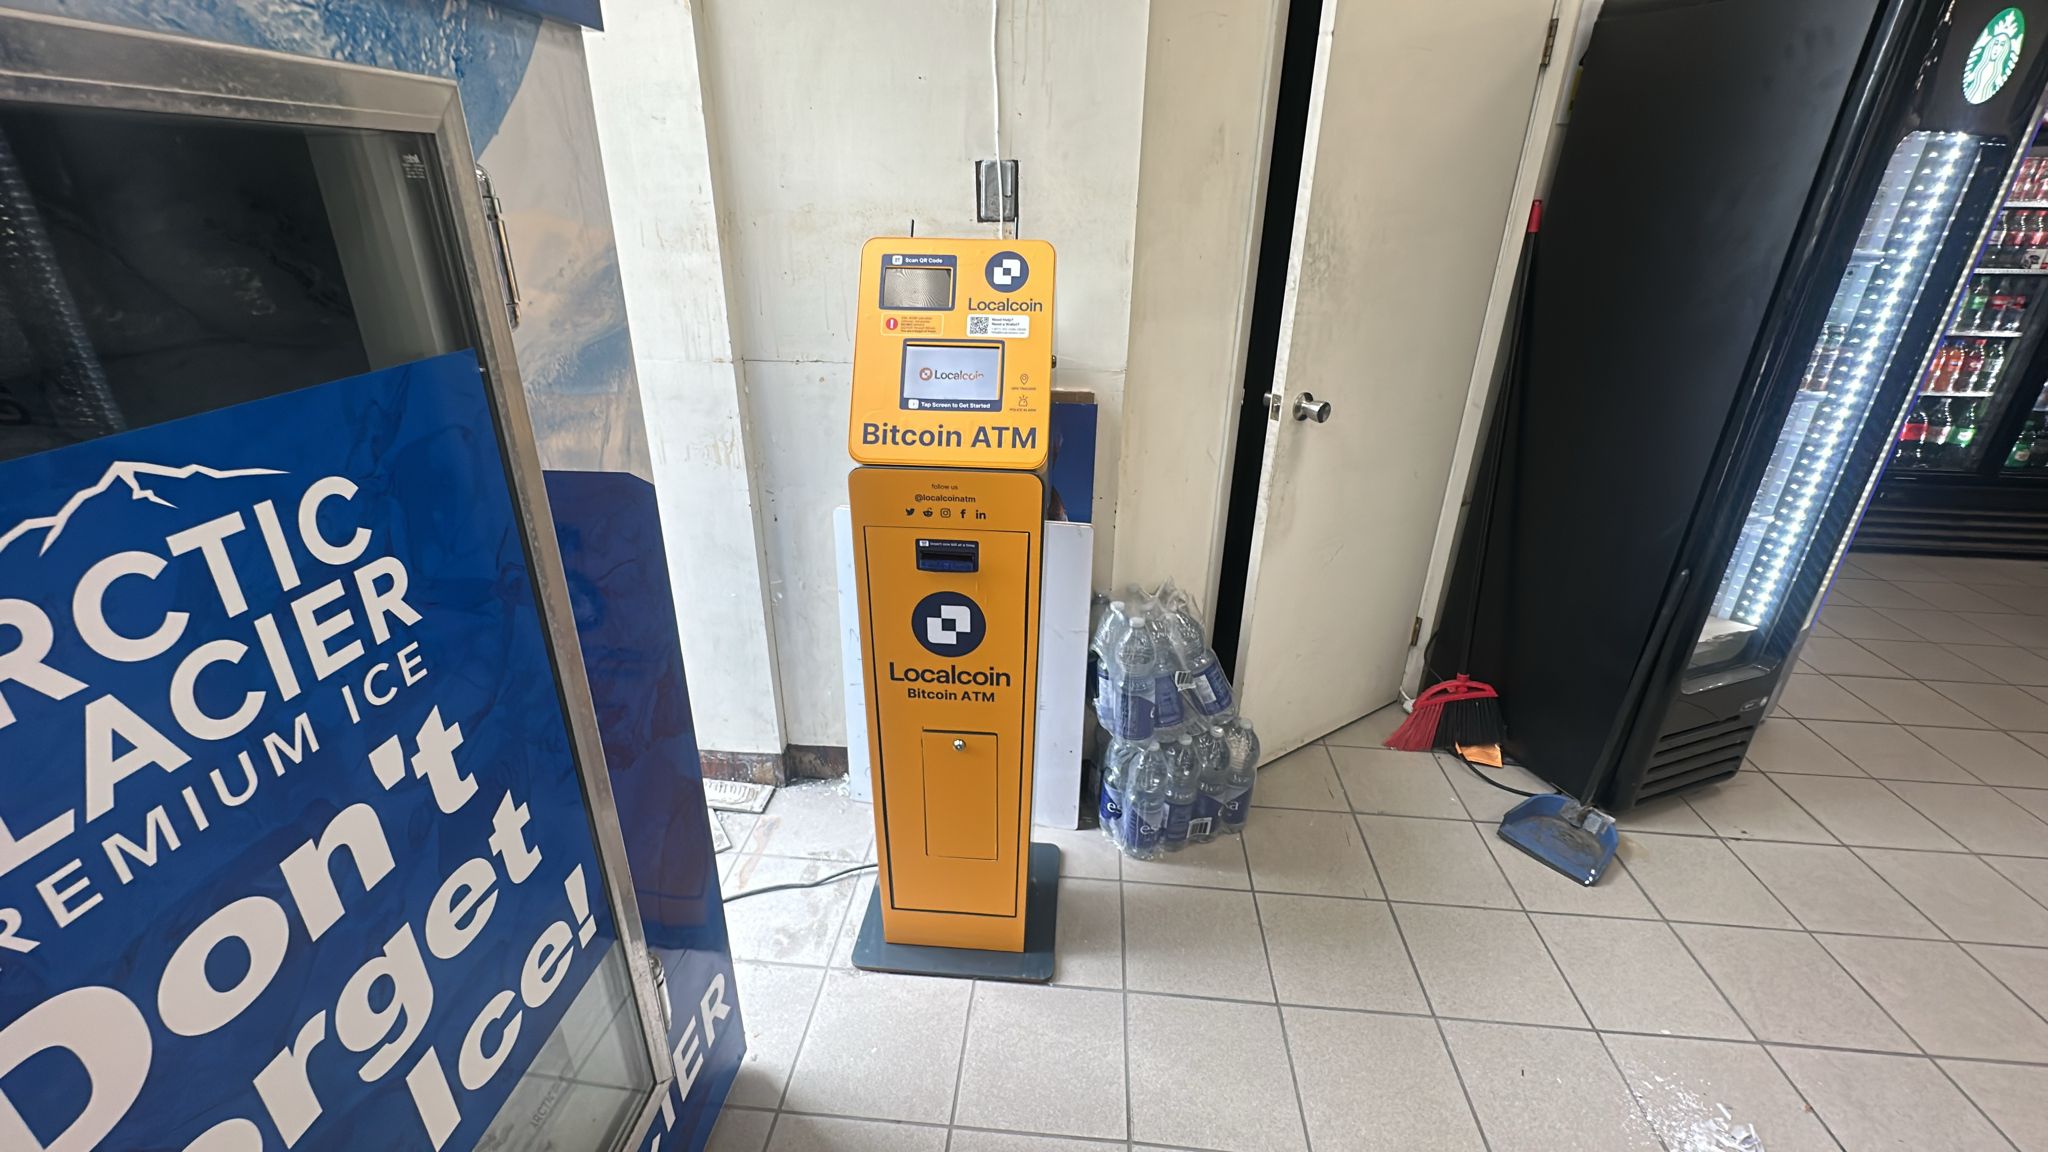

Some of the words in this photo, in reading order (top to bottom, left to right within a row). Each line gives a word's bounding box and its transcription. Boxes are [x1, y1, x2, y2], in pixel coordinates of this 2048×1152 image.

[968, 297, 1043, 313] Localcoin
[934, 369, 984, 381] Localcoin
[862, 422, 962, 447] Bitcoin
[971, 425, 1037, 449] ATM
[915, 493, 976, 503] @localcoinatm
[341, 641, 428, 724] ICE
[889, 661, 1011, 687] Localcoin
[907, 688, 957, 701] Bitcoin
[961, 691, 995, 703] ATM
[0, 704, 479, 1152] Don't
[180, 789, 543, 1152] rget
[405, 864, 597, 1152] Ice!
